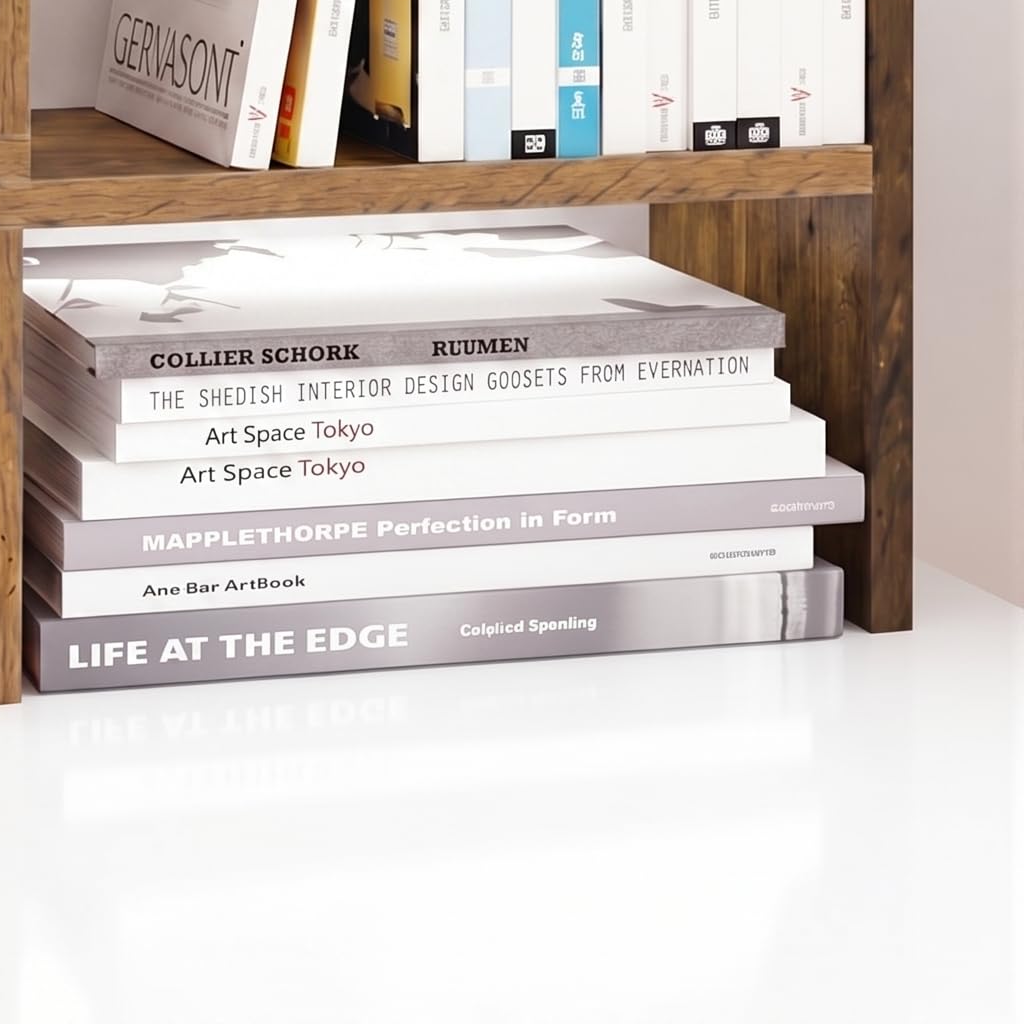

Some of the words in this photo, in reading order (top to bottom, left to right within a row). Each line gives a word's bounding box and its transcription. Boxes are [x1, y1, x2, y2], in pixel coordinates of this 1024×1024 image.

[150, 349, 255, 369] COLLIER
[261, 344, 360, 364] SCHORK
[432, 337, 529, 357] RUUMEN
[149, 390, 185, 410] THE
[199, 385, 283, 408] SHEDISH
[298, 378, 392, 402] INTERIOR
[405, 373, 474, 396] DESIGN
[487, 368, 567, 391] GOOSETS
[581, 363, 625, 385] FROM
[638, 356, 749, 380] EVERNATION
[205, 427, 237, 445] Art
[244, 425, 306, 447] Space
[311, 419, 374, 442] Tokyo
[180, 466, 215, 484] Art
[224, 464, 292, 485] Space
[298, 458, 366, 480] Tokyo
[142, 522, 368, 551] MAPPLETHORPE
[377, 515, 511, 537] Perfection
[520, 512, 544, 528] in
[553, 509, 617, 526] Form
[142, 584, 180, 597] Ane
[186, 582, 220, 594] Bar
[225, 575, 306, 592] ArtBook
[68, 640, 148, 669] LIFE
[159, 636, 209, 663] AT
[219, 631, 295, 658] THE
[306, 623, 409, 654] EDGE
